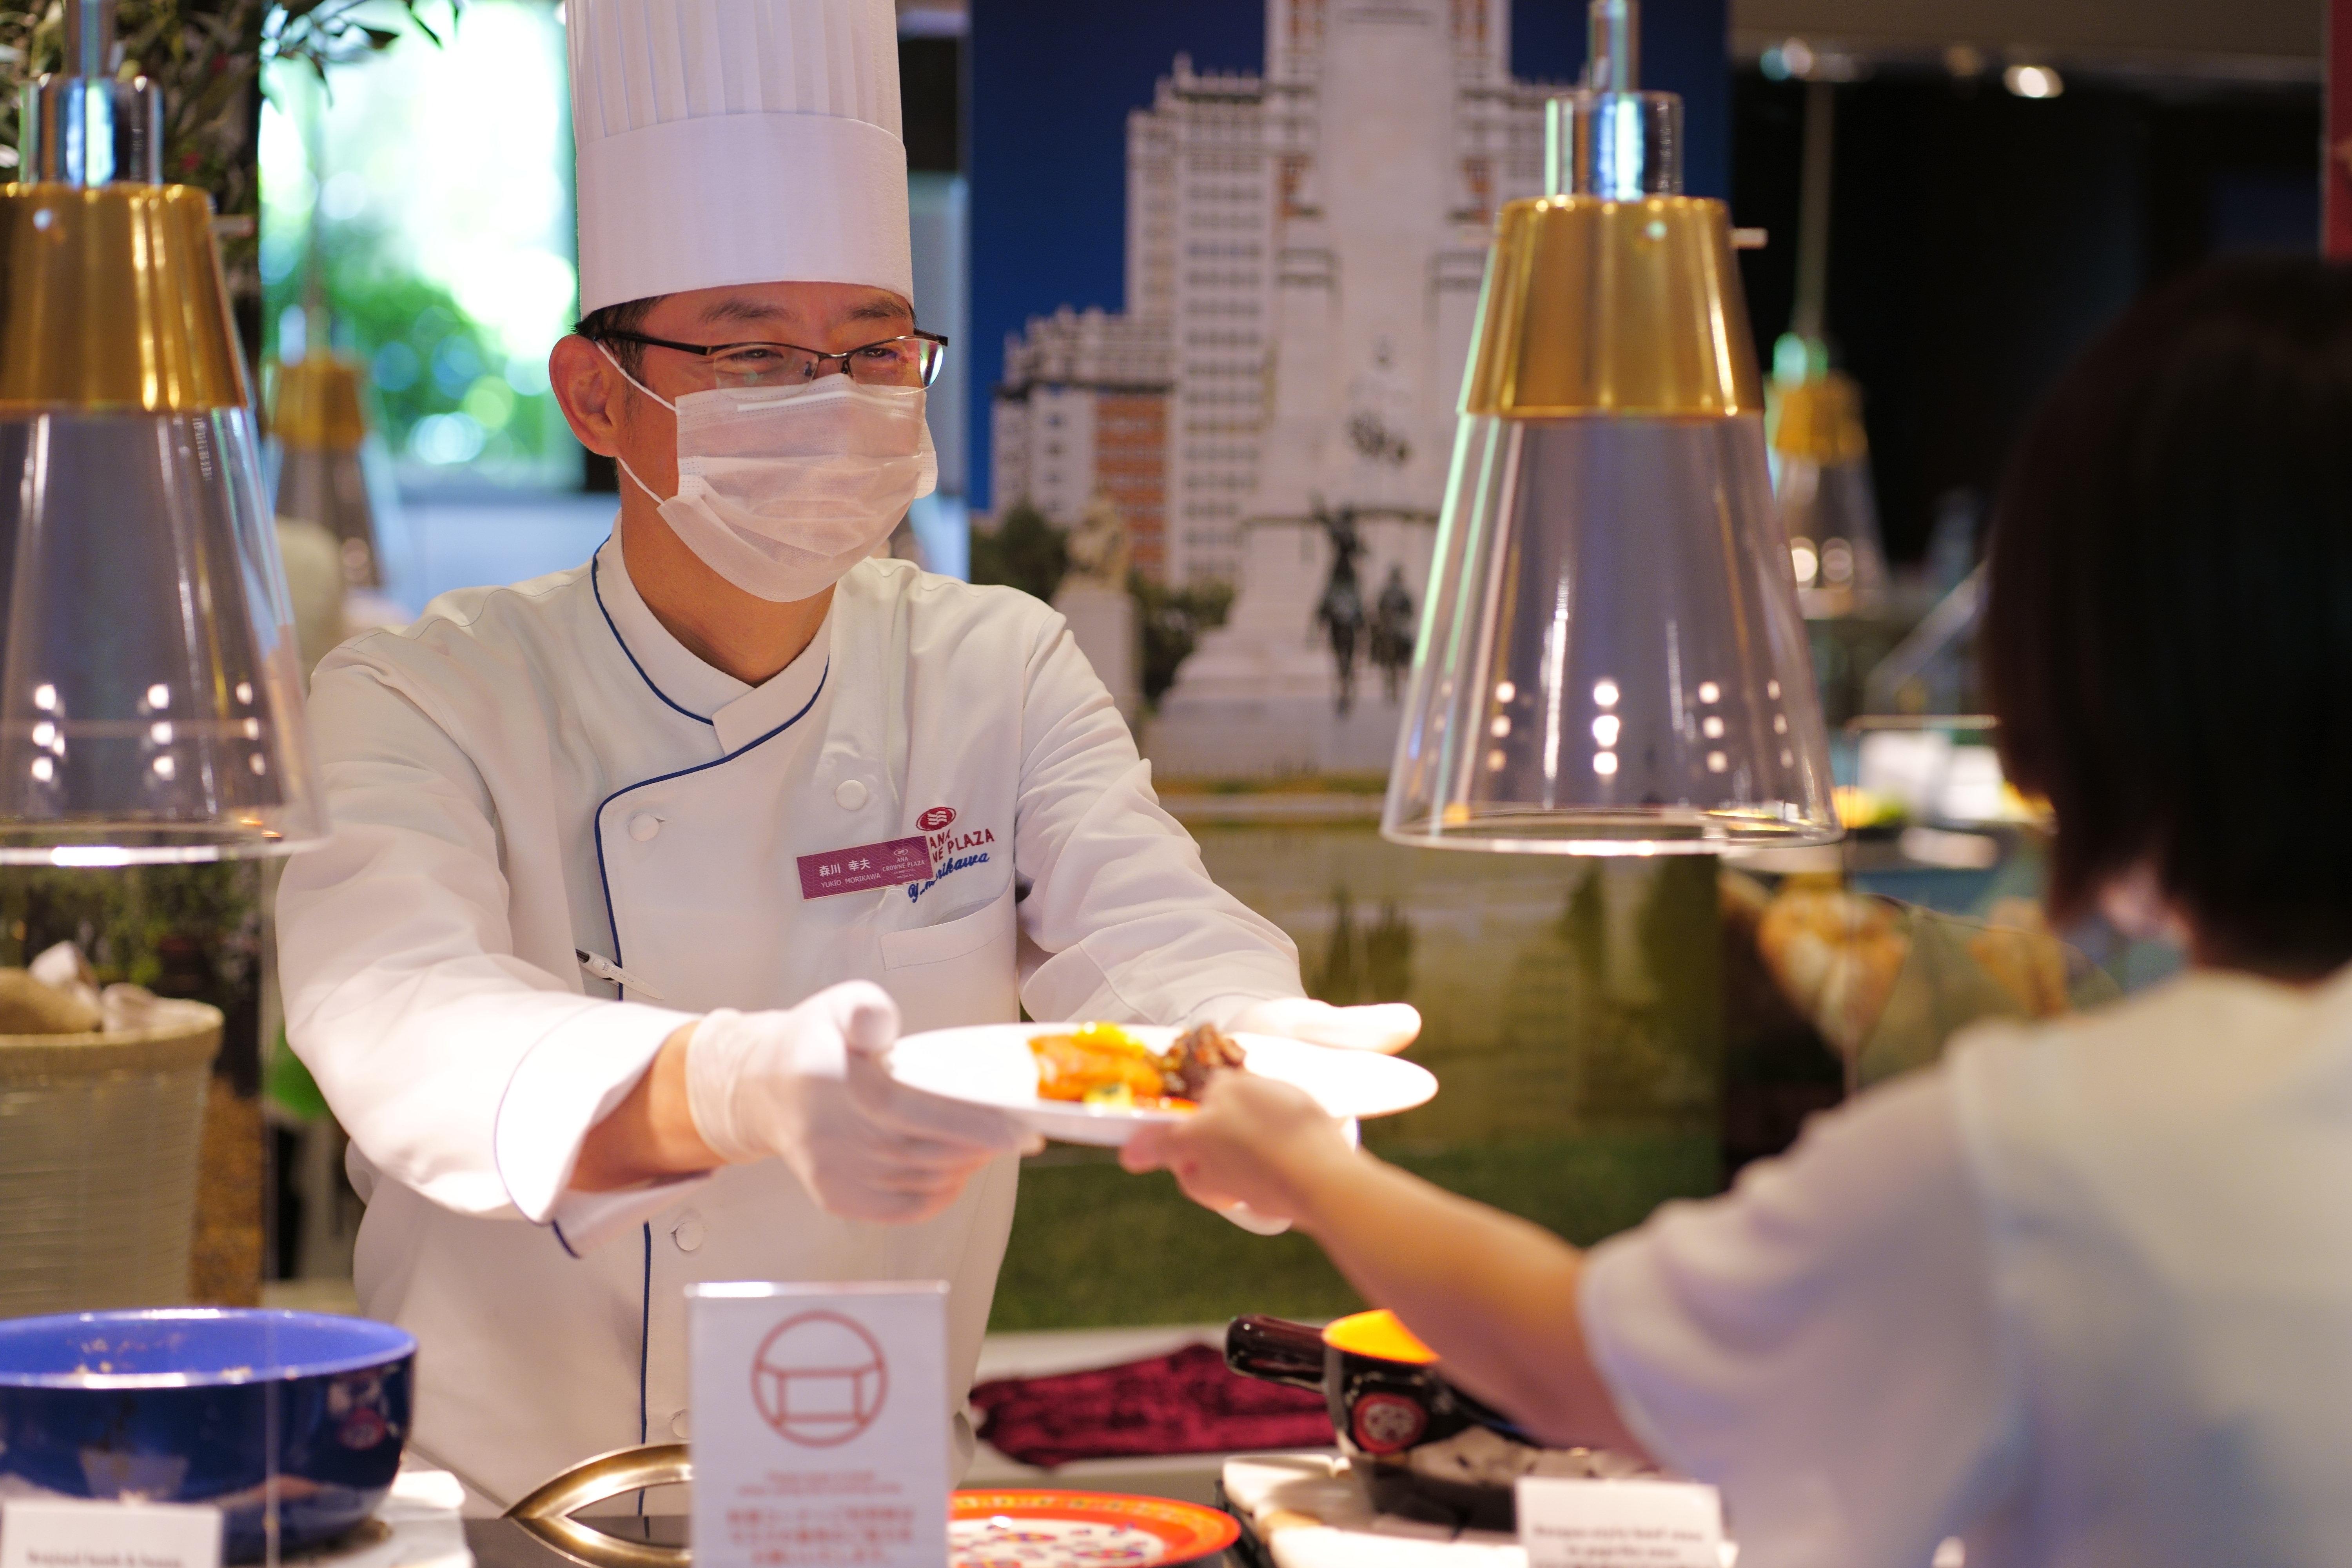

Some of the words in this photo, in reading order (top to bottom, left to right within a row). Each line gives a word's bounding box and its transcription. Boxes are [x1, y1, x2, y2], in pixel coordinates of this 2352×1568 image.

[947, 828, 995, 854] PLAZA
[819, 863, 841, 877] 森川
[848, 858, 871, 871] 幸夫
[882, 863, 906, 872] CROWNE
[821, 879, 842, 888] YUKIO
[845, 873, 881, 884] MORIKAWA
